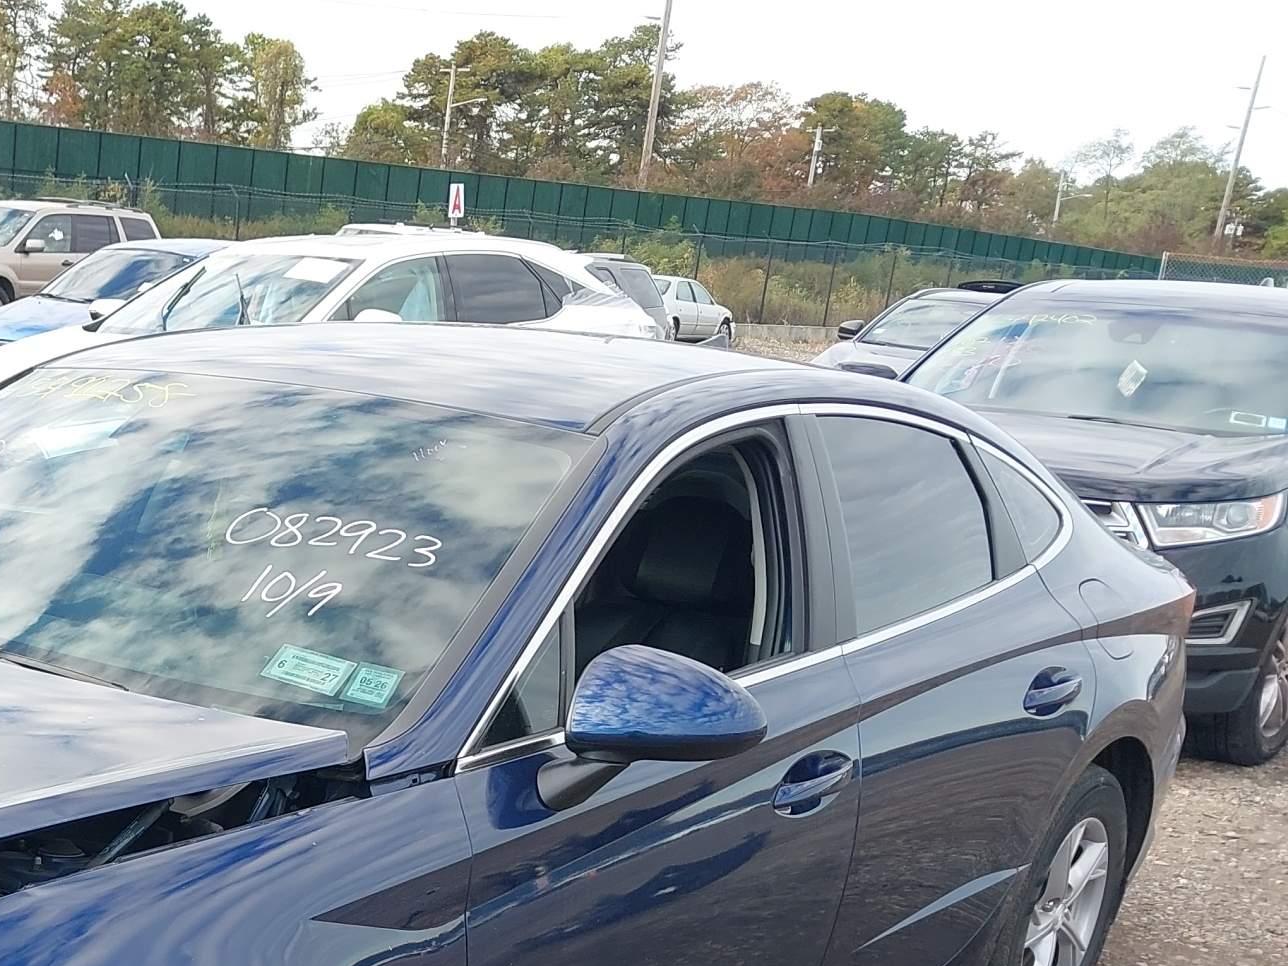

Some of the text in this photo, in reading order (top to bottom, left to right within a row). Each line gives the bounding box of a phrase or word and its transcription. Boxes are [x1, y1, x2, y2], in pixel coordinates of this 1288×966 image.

[452, 184, 461, 214] A
[225, 507, 443, 567] 082923
[241, 564, 343, 617] 10/9
[277, 659, 287, 669] 6
[320, 672, 339, 683] 27
